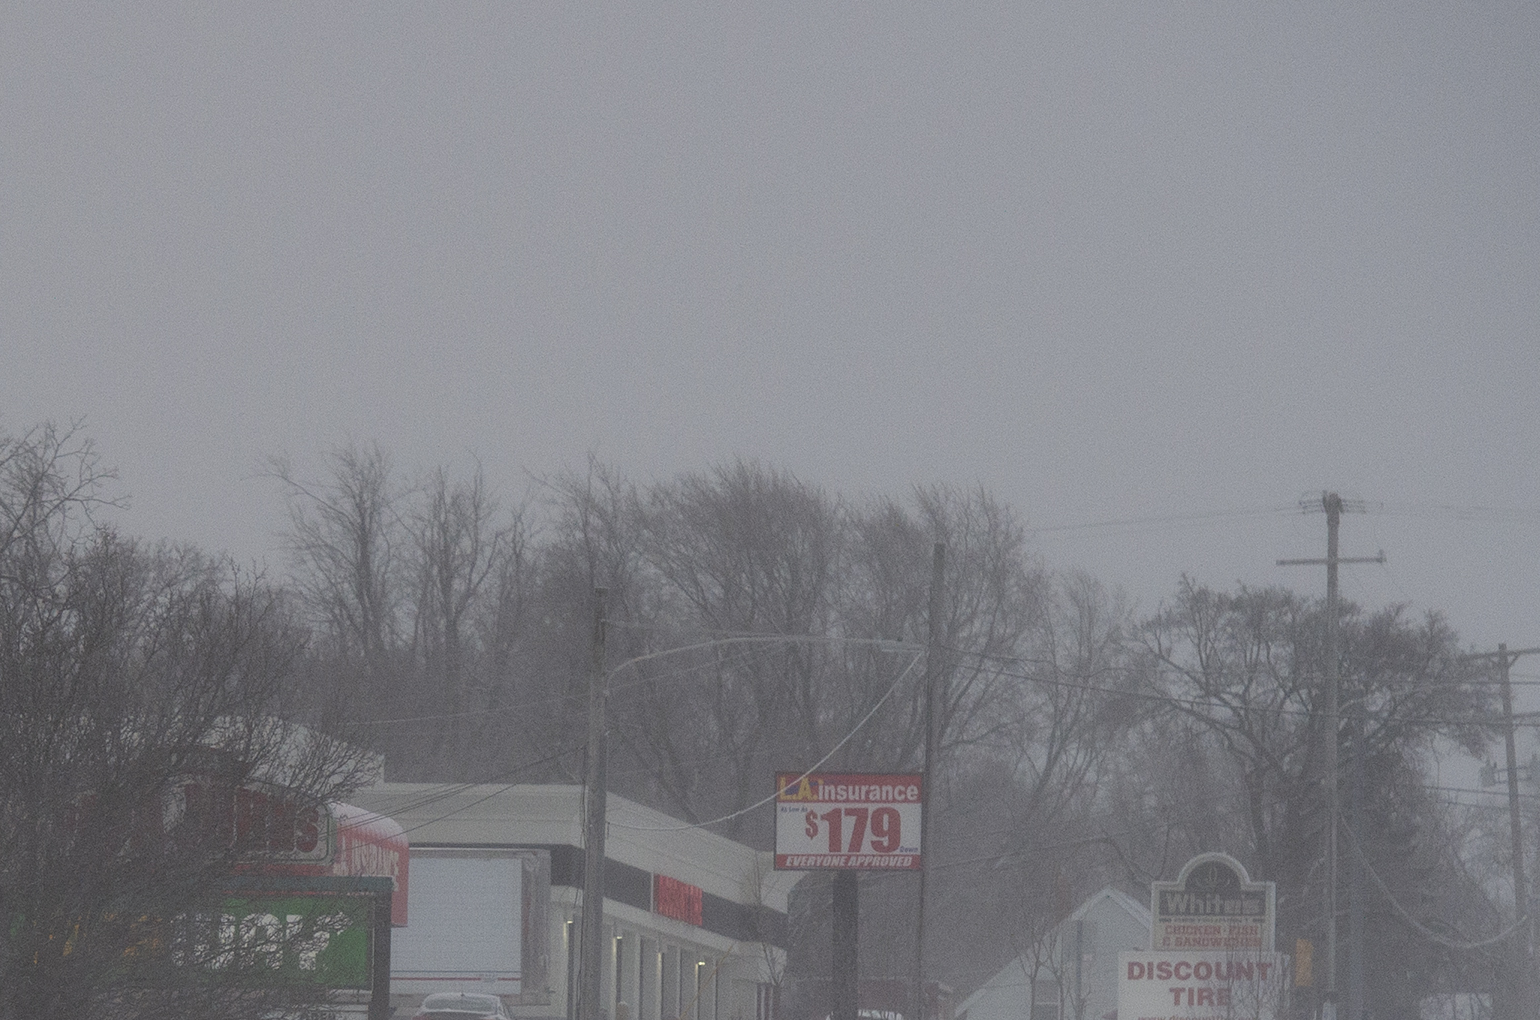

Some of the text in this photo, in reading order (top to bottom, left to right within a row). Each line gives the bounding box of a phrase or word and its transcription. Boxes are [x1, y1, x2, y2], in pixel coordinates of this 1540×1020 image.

[817, 781, 919, 801] insurance
[805, 807, 901, 853] $179
[785, 856, 913, 867] EVERYONE APPROVED
[1164, 925, 1221, 935] CHICKEN
[1127, 961, 1272, 981] DISCOUNT
[1169, 987, 1232, 1007] TIRE
